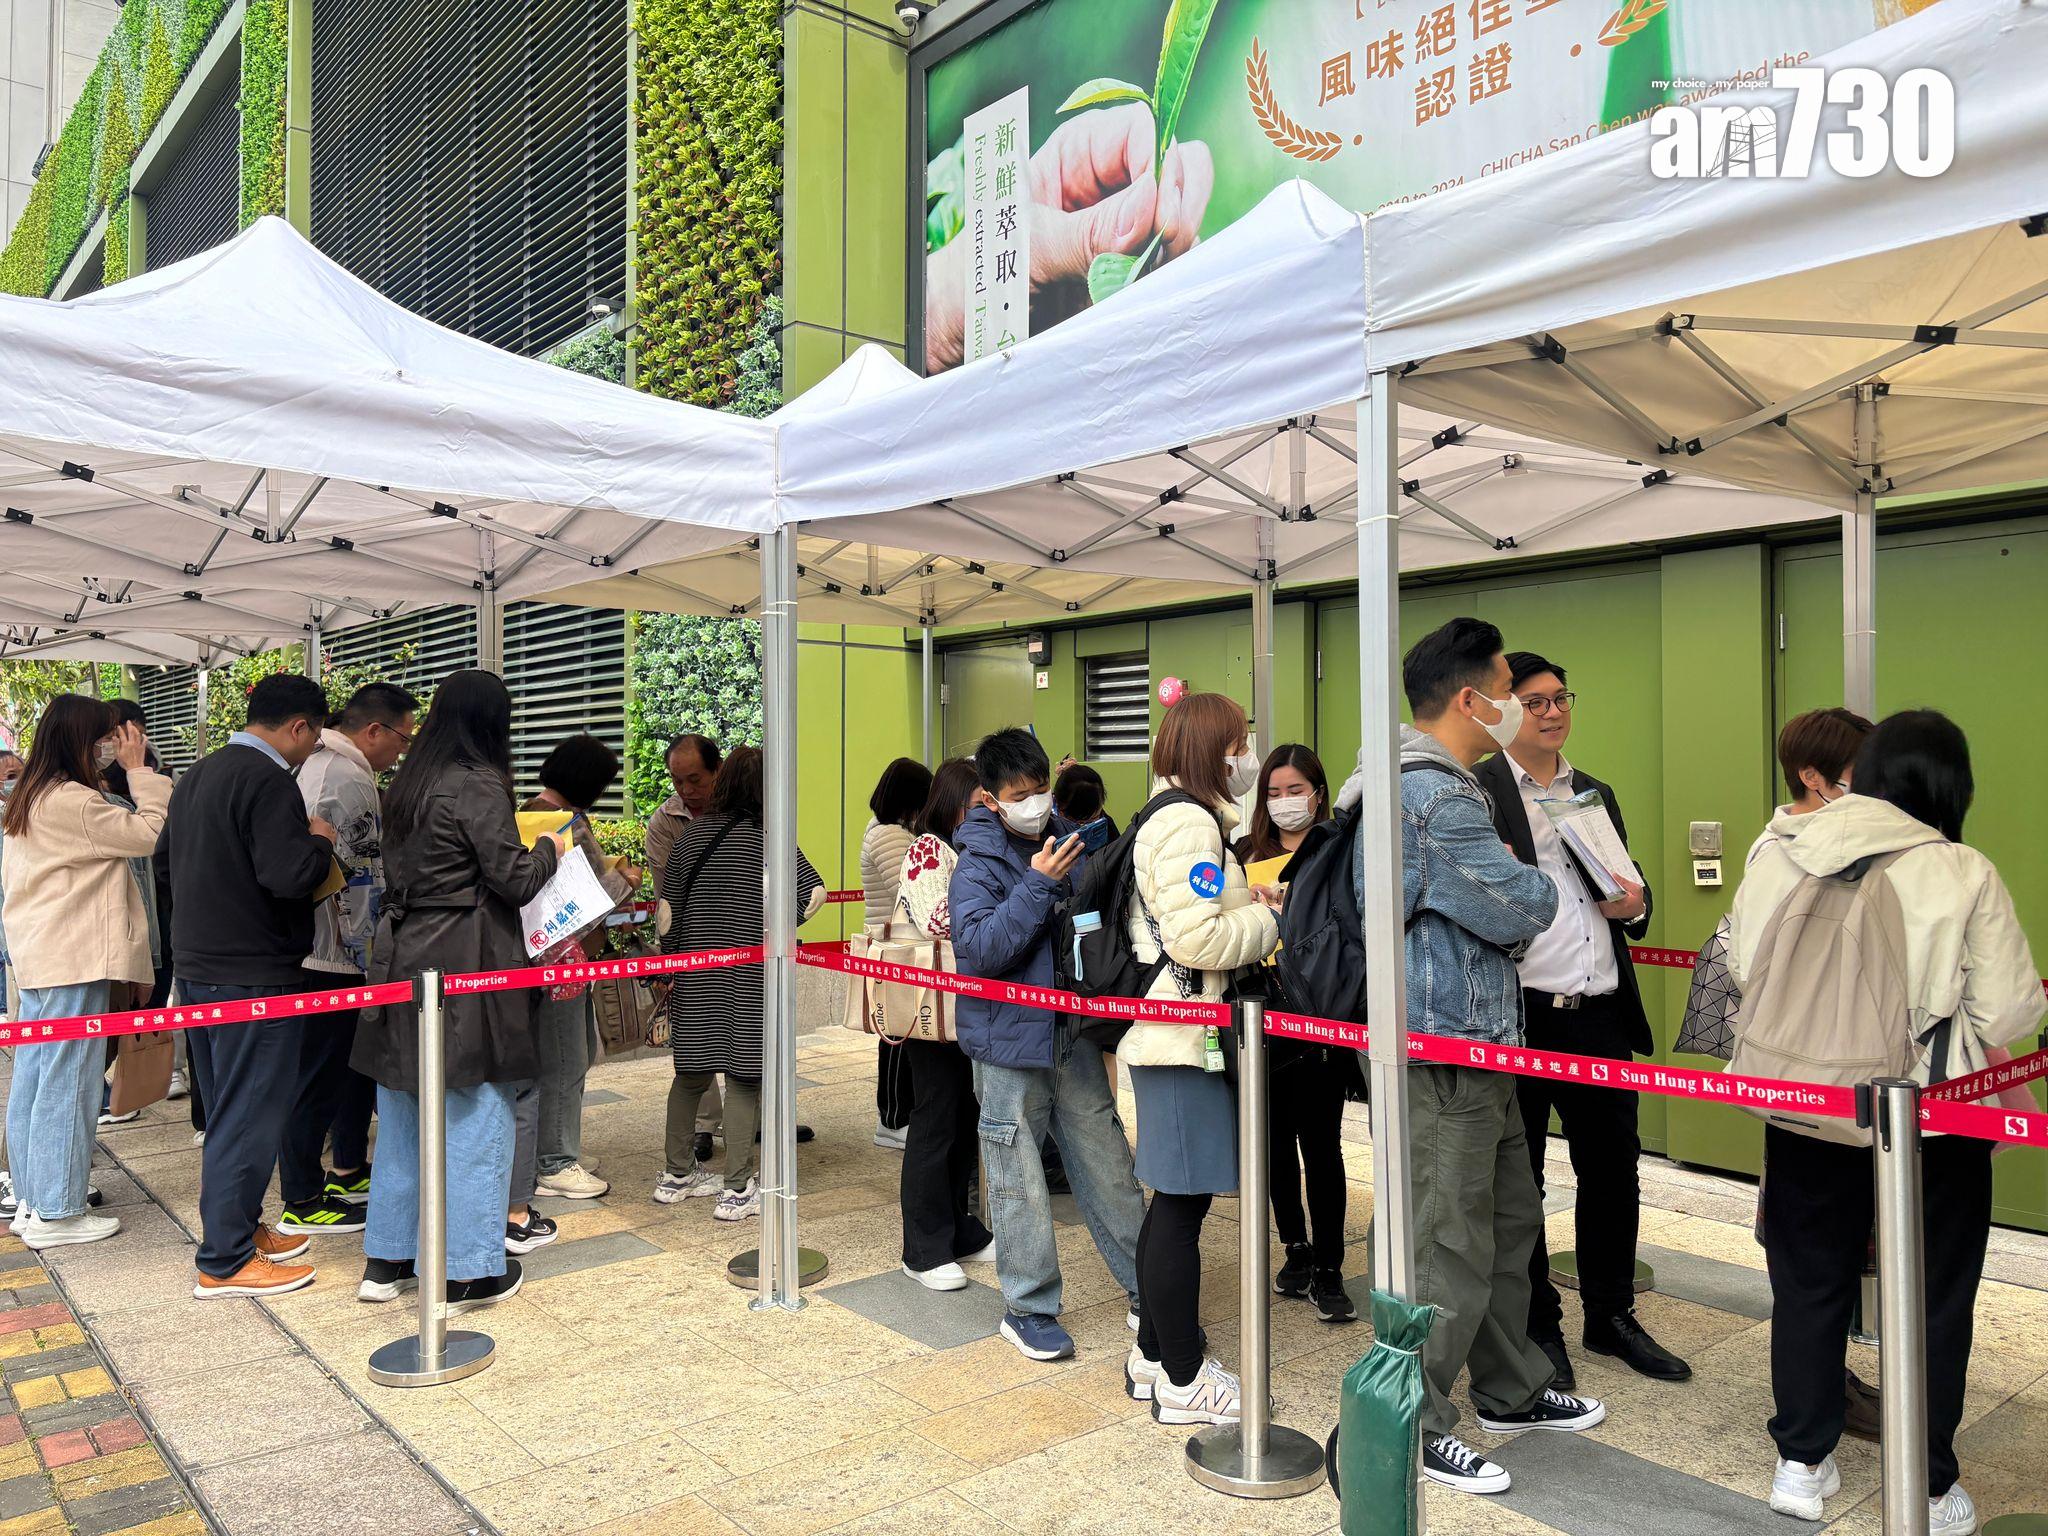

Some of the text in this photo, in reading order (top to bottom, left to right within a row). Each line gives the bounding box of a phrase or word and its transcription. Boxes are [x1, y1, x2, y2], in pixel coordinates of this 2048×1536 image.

[1318, 0, 1561, 107] 風味絕佳
[1415, 42, 1512, 127] 認證
[1481, 145, 1543, 177] CHICHA
[1550, 135, 1581, 151] San
[1774, 51, 1809, 69] the
[974, 133, 987, 360] Freshly extracted Taiwa
[645, 951, 751, 971] Sun Hung Kai Properties
[456, 975, 508, 989] Properties
[904, 969, 983, 992] Sun Hung Kai Properties
[919, 1004, 933, 1036] Chloé
[1087, 999, 1217, 1019] Sun Hung Kai Properties
[1280, 1018, 1301, 1032] Sun
[1305, 1021, 1335, 1041] Hung
[1339, 1027, 1358, 1042] Kai
[1620, 1068, 1826, 1105] Sun Hung Kai Properties
